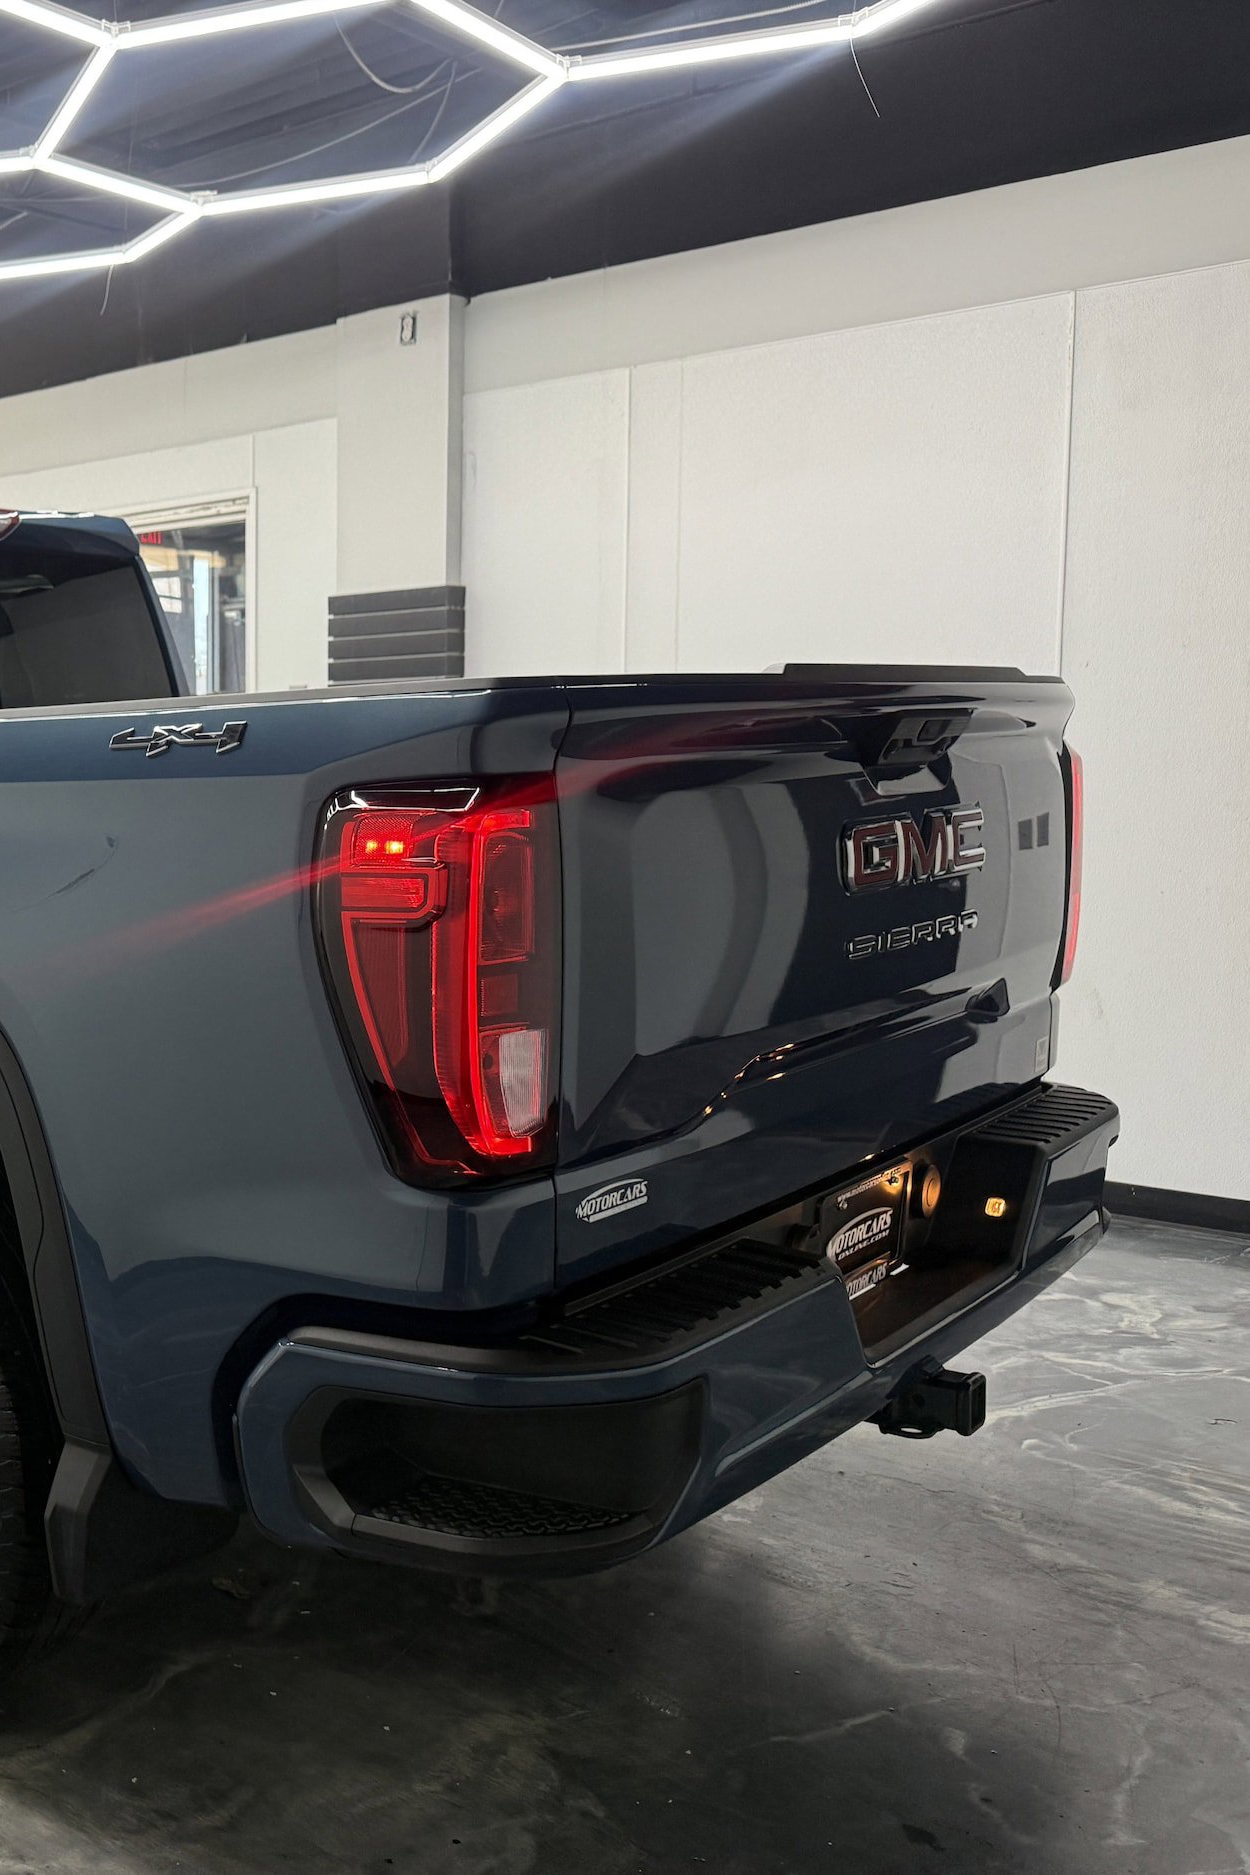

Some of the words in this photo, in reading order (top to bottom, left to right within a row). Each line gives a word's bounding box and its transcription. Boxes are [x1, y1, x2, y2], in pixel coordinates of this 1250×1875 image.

[840, 806, 986, 893] GMC
[847, 909, 978, 959] SIERRA
[576, 1180, 648, 1219] MOTORCARS
[829, 1210, 893, 1259] MOTORCARS
[837, 1229, 890, 1261] ONLINE.COM
[846, 1262, 888, 1298] OTORCARS
